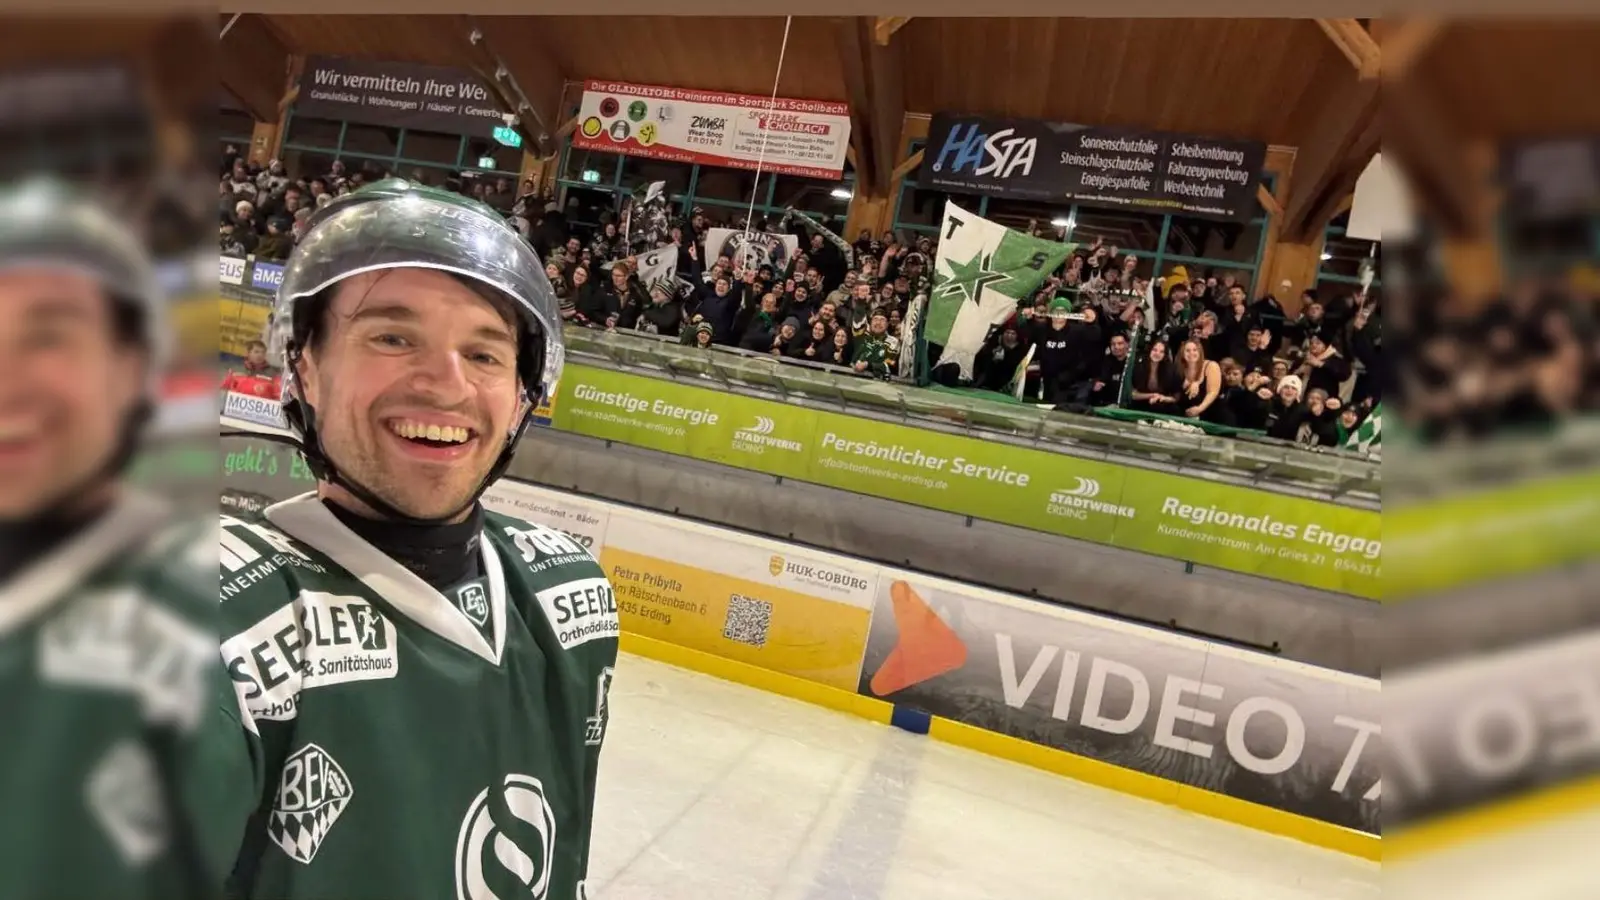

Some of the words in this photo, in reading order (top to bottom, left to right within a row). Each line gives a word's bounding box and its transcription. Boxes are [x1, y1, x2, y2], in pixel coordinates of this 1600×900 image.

[314, 69, 340, 86] Wir
[342, 73, 420, 94] vermitteln
[424, 79, 456, 99] Ihre
[368, 95, 418, 111] Wohnungen
[426, 102, 457, 114] Häuser
[591, 82, 606, 91] Die
[607, 84, 676, 98] GLADIATORS
[677, 91, 724, 104] trainieren
[724, 95, 737, 105] im
[738, 96, 787, 111] Sportpark
[789, 99, 848, 114] Schollbach!
[690, 115, 726, 131] ZUMBA
[748, 110, 800, 123] SPORTPARK
[763, 119, 826, 134] SCHOLLBACH
[687, 135, 723, 147] ERDING
[688, 128, 705, 137] Wear
[706, 130, 724, 139] Shop
[1079, 135, 1159, 156] Sonnenschutzfolie
[1170, 142, 1245, 165] Scheibentönung
[1059, 151, 1155, 174] Steinschlagschutzfolie
[1166, 161, 1250, 184] Fahrzeugwerbung
[1080, 171, 1151, 191] Energiesparfolie
[1162, 179, 1226, 199] Werbetechnik
[573, 383, 650, 413] Günstige
[652, 399, 720, 427] Energie
[731, 440, 765, 454] ERDING
[733, 430, 803, 452] STADTWERKE
[820, 432, 949, 472] Persönlicher
[950, 456, 1031, 487] Service
[1046, 504, 1088, 521] ERDING
[1049, 492, 1136, 519] STADTWERKE
[575, 514, 600, 526] Bäder
[1161, 496, 1299, 540] Regionales
[1302, 523, 1381, 559] Engag
[1254, 542, 1277, 556] Am
[1278, 548, 1309, 564] Gries
[1311, 554, 1326, 566] 21
[613, 564, 640, 585] Petra
[642, 572, 683, 592] Pribylla
[786, 562, 868, 590] HUK-COBURG
[629, 586, 698, 613] Rätschenbach
[699, 602, 708, 615] 6
[640, 606, 672, 626] Erding
[318, 654, 393, 676] Sanitätshaus
[994, 632, 1306, 776] VIDEO
[280, 750, 330, 811] BEV
